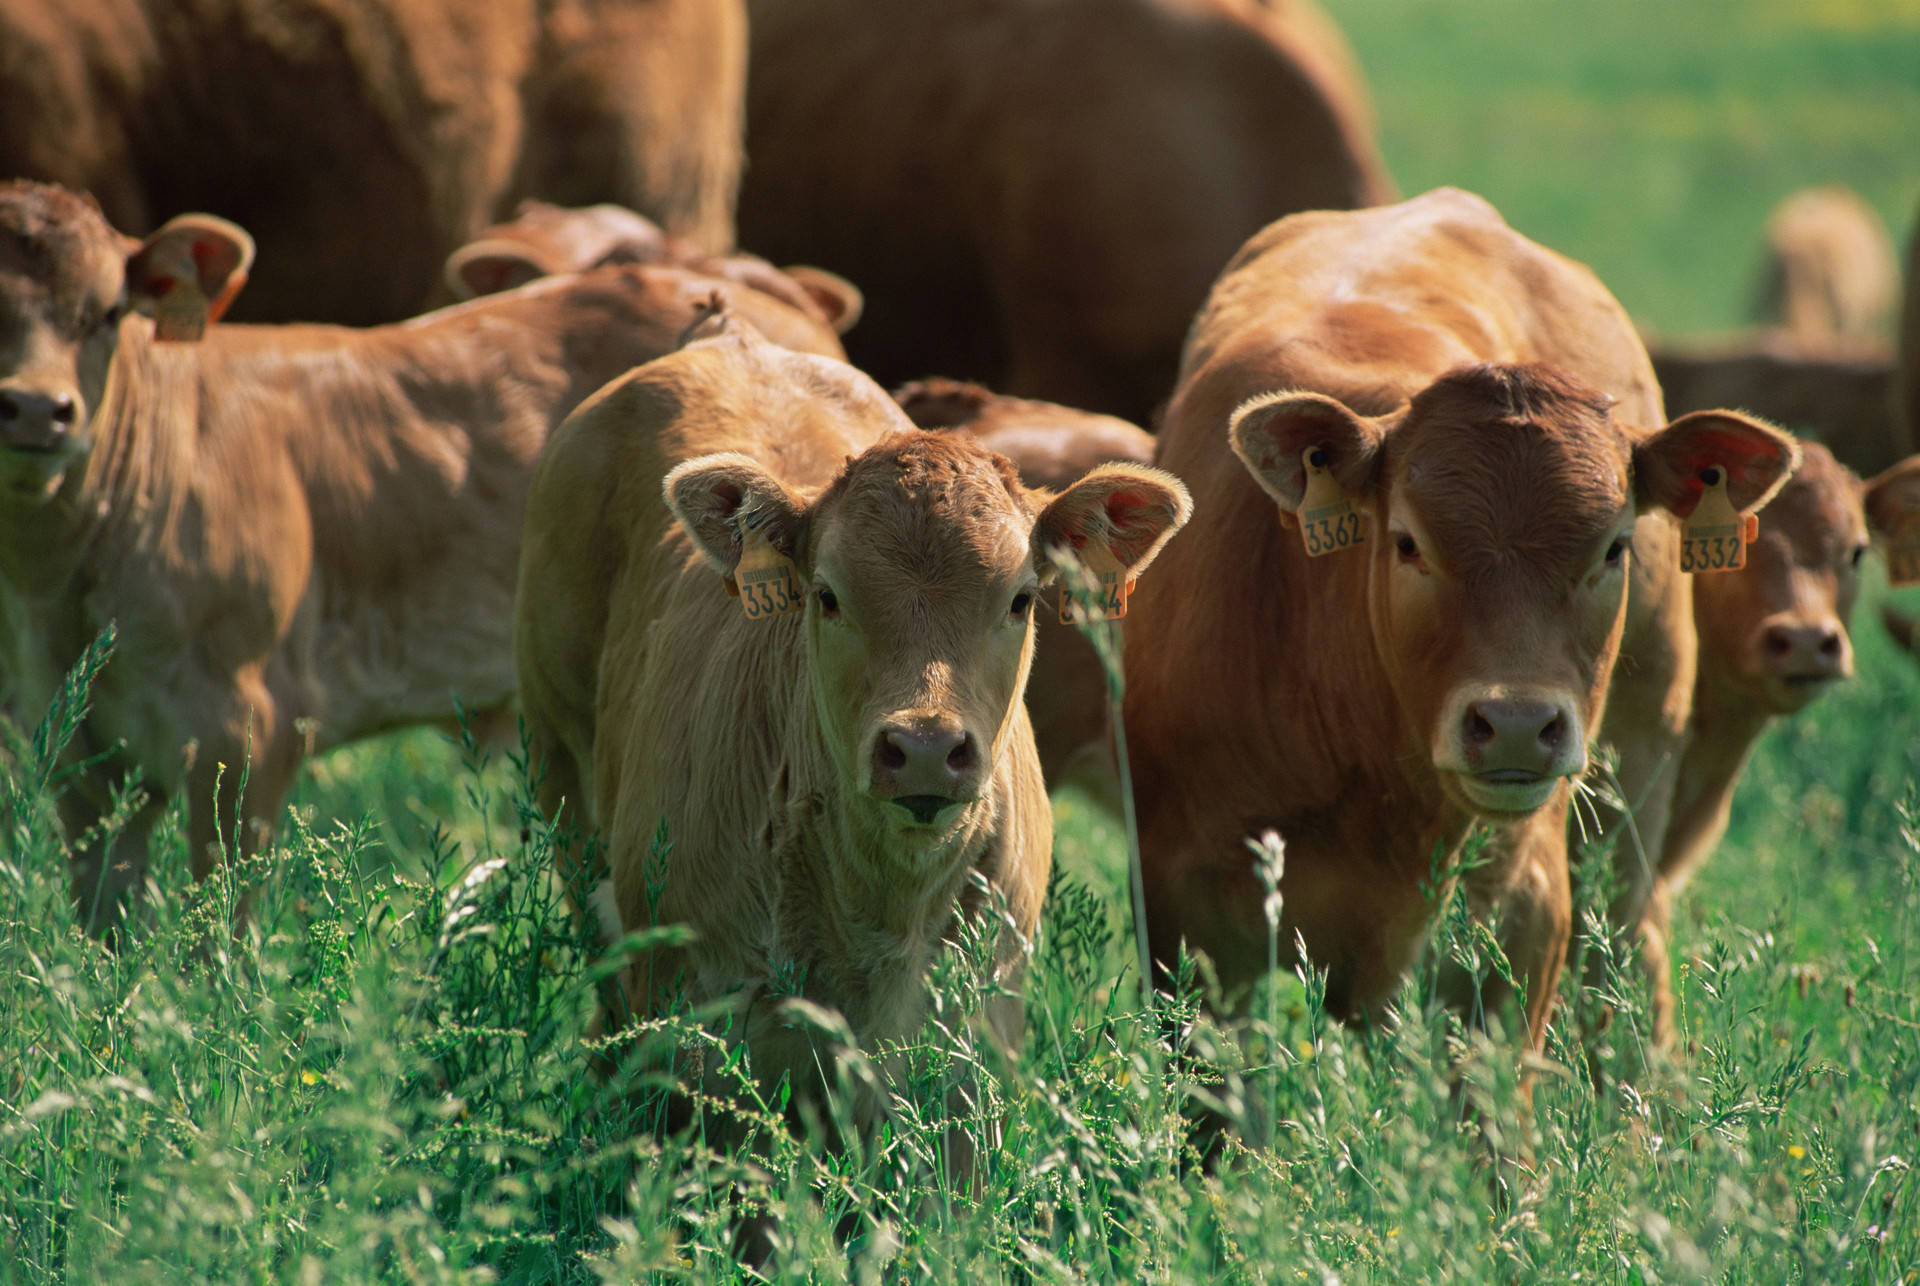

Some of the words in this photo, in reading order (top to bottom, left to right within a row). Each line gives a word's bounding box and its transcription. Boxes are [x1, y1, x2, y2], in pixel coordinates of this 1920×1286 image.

[1304, 513, 1364, 553] 3362
[1681, 538, 1740, 571] 3332
[743, 577, 801, 616] 3334
[1061, 584, 1121, 621] 34
